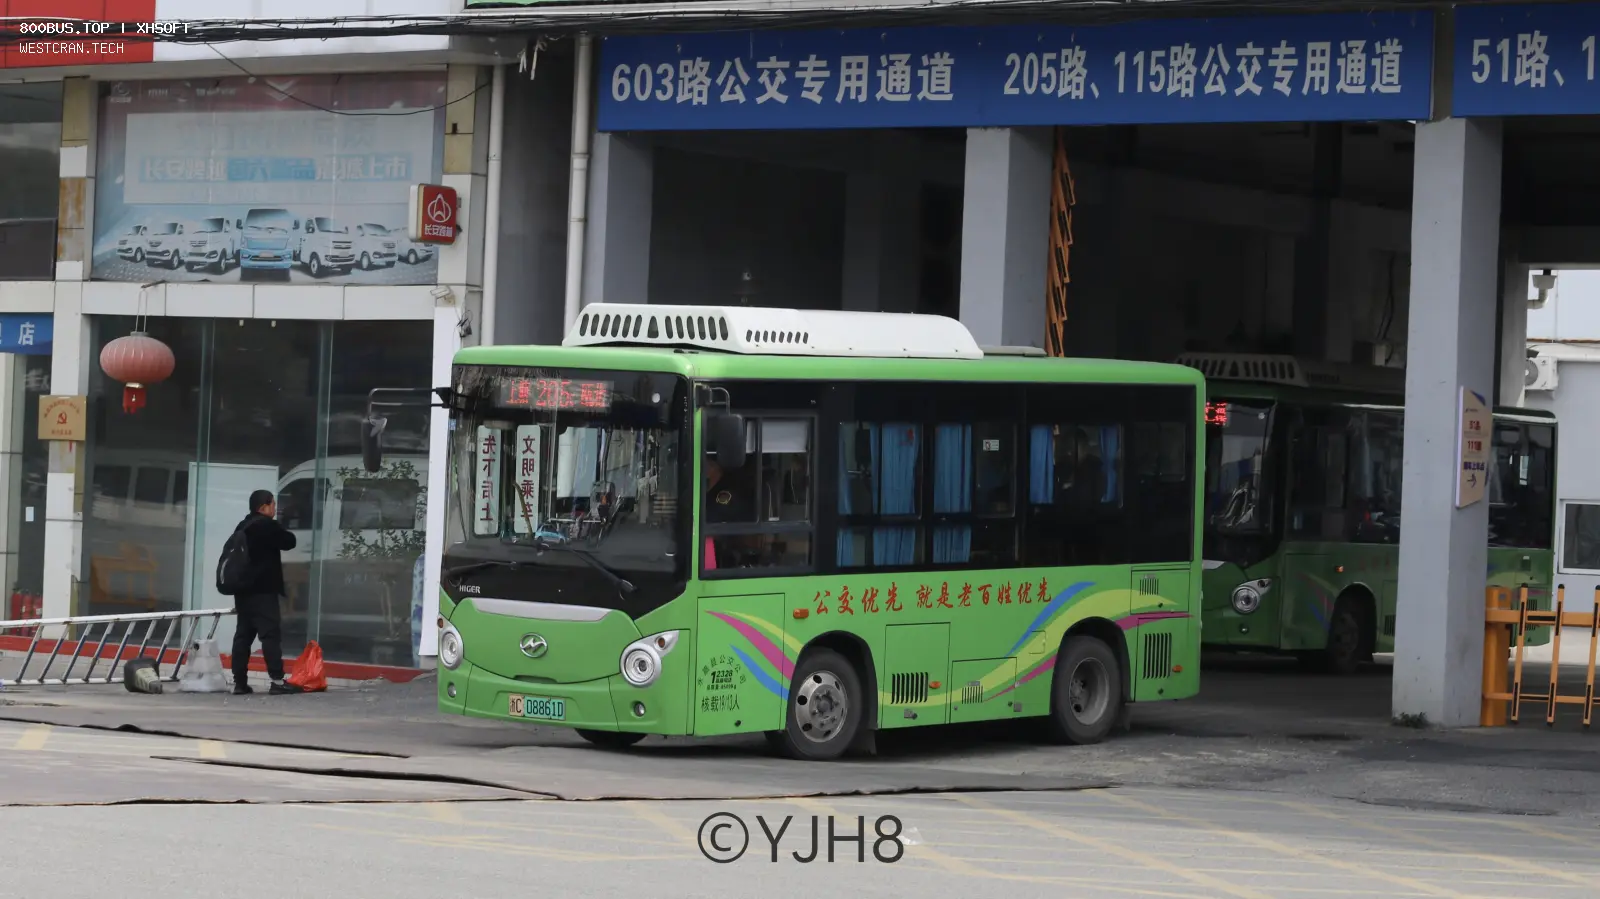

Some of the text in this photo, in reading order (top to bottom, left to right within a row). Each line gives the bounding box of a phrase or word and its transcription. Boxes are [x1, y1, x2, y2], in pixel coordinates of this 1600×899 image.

[611, 52, 955, 106] 603路公交专用通道
[459, 584, 481, 594] HIGER
[813, 576, 1052, 615] 公交优先 就是老百姓优先
